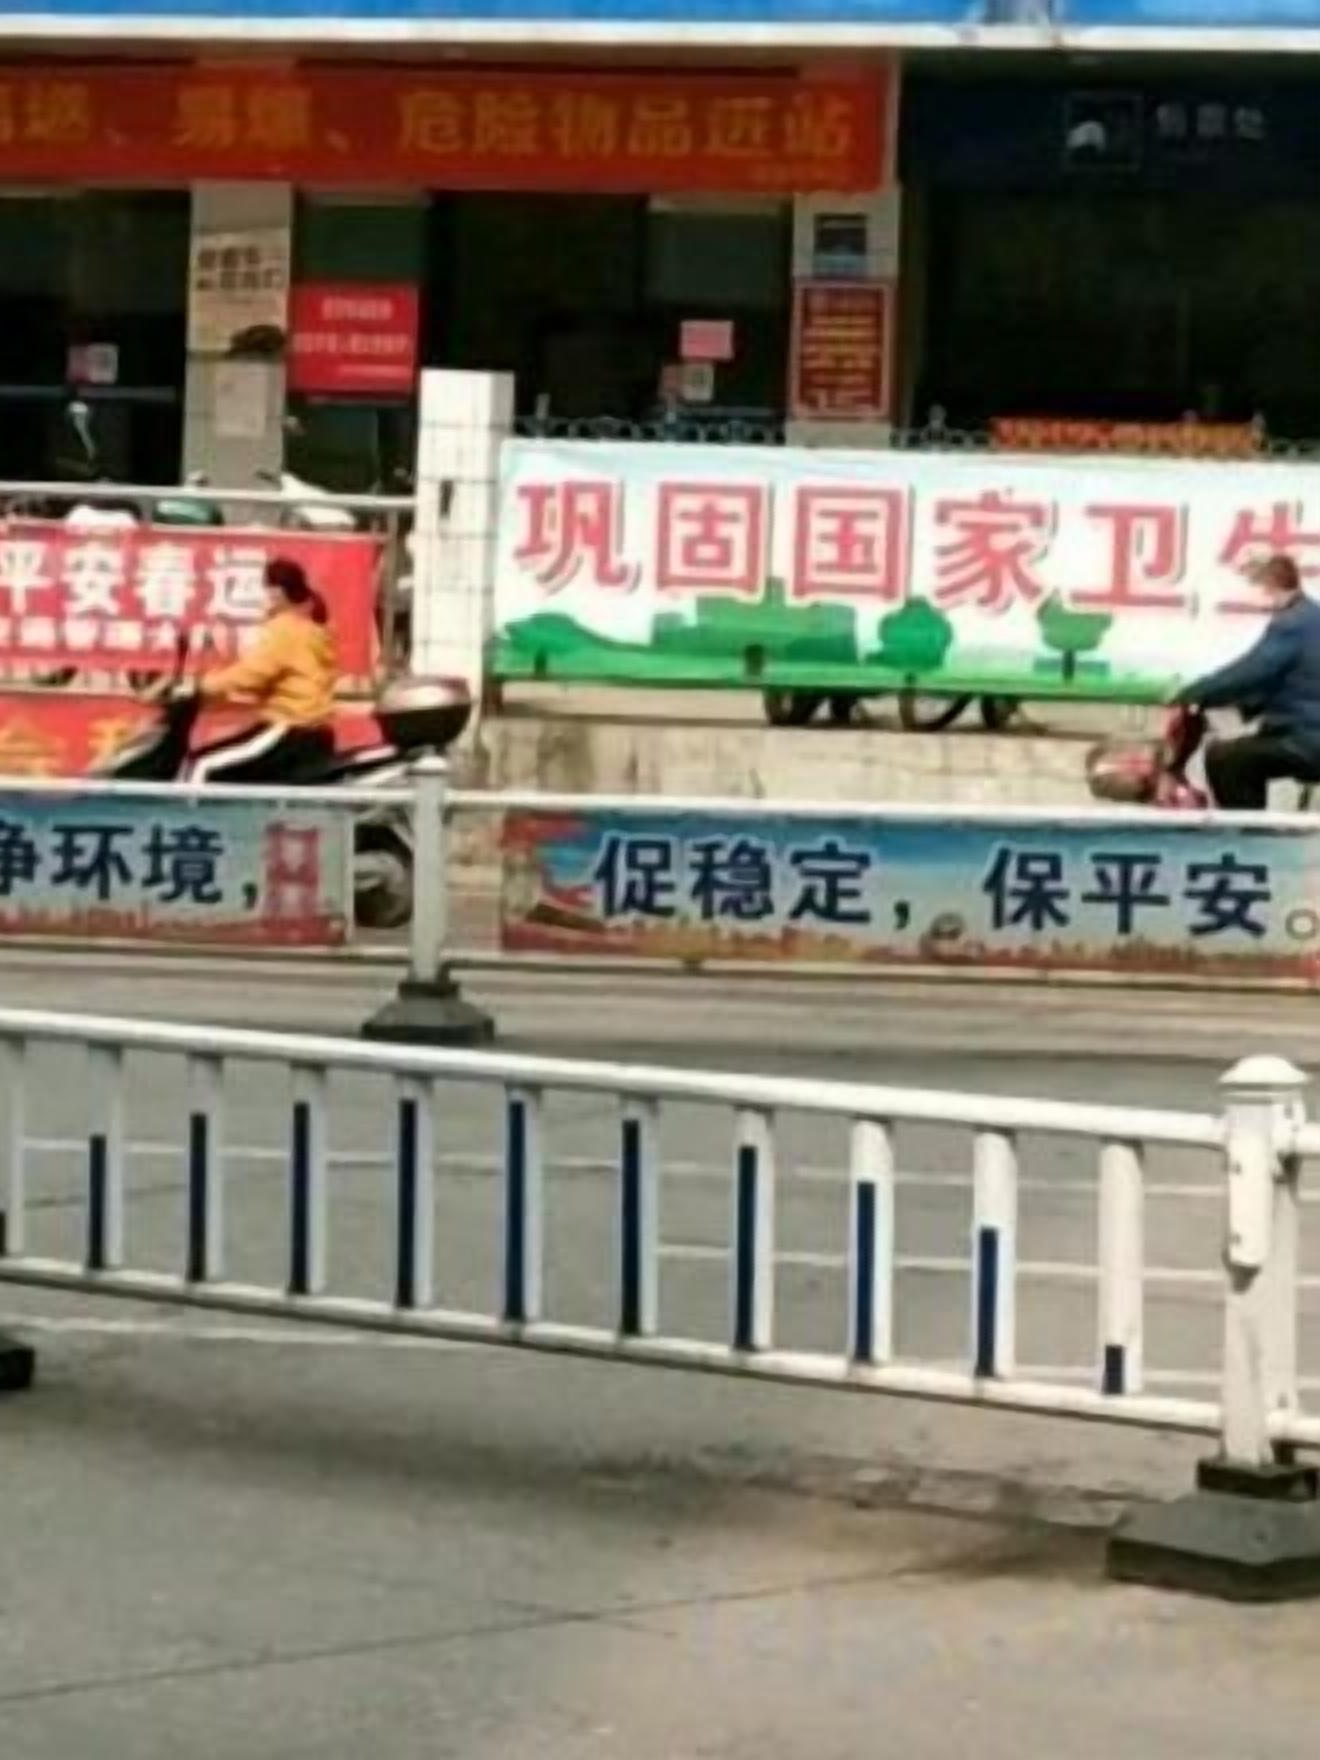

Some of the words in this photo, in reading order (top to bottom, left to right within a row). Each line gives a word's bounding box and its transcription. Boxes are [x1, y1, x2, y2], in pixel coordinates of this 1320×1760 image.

[592, 832, 1319, 942] 促稳定，保平安。
